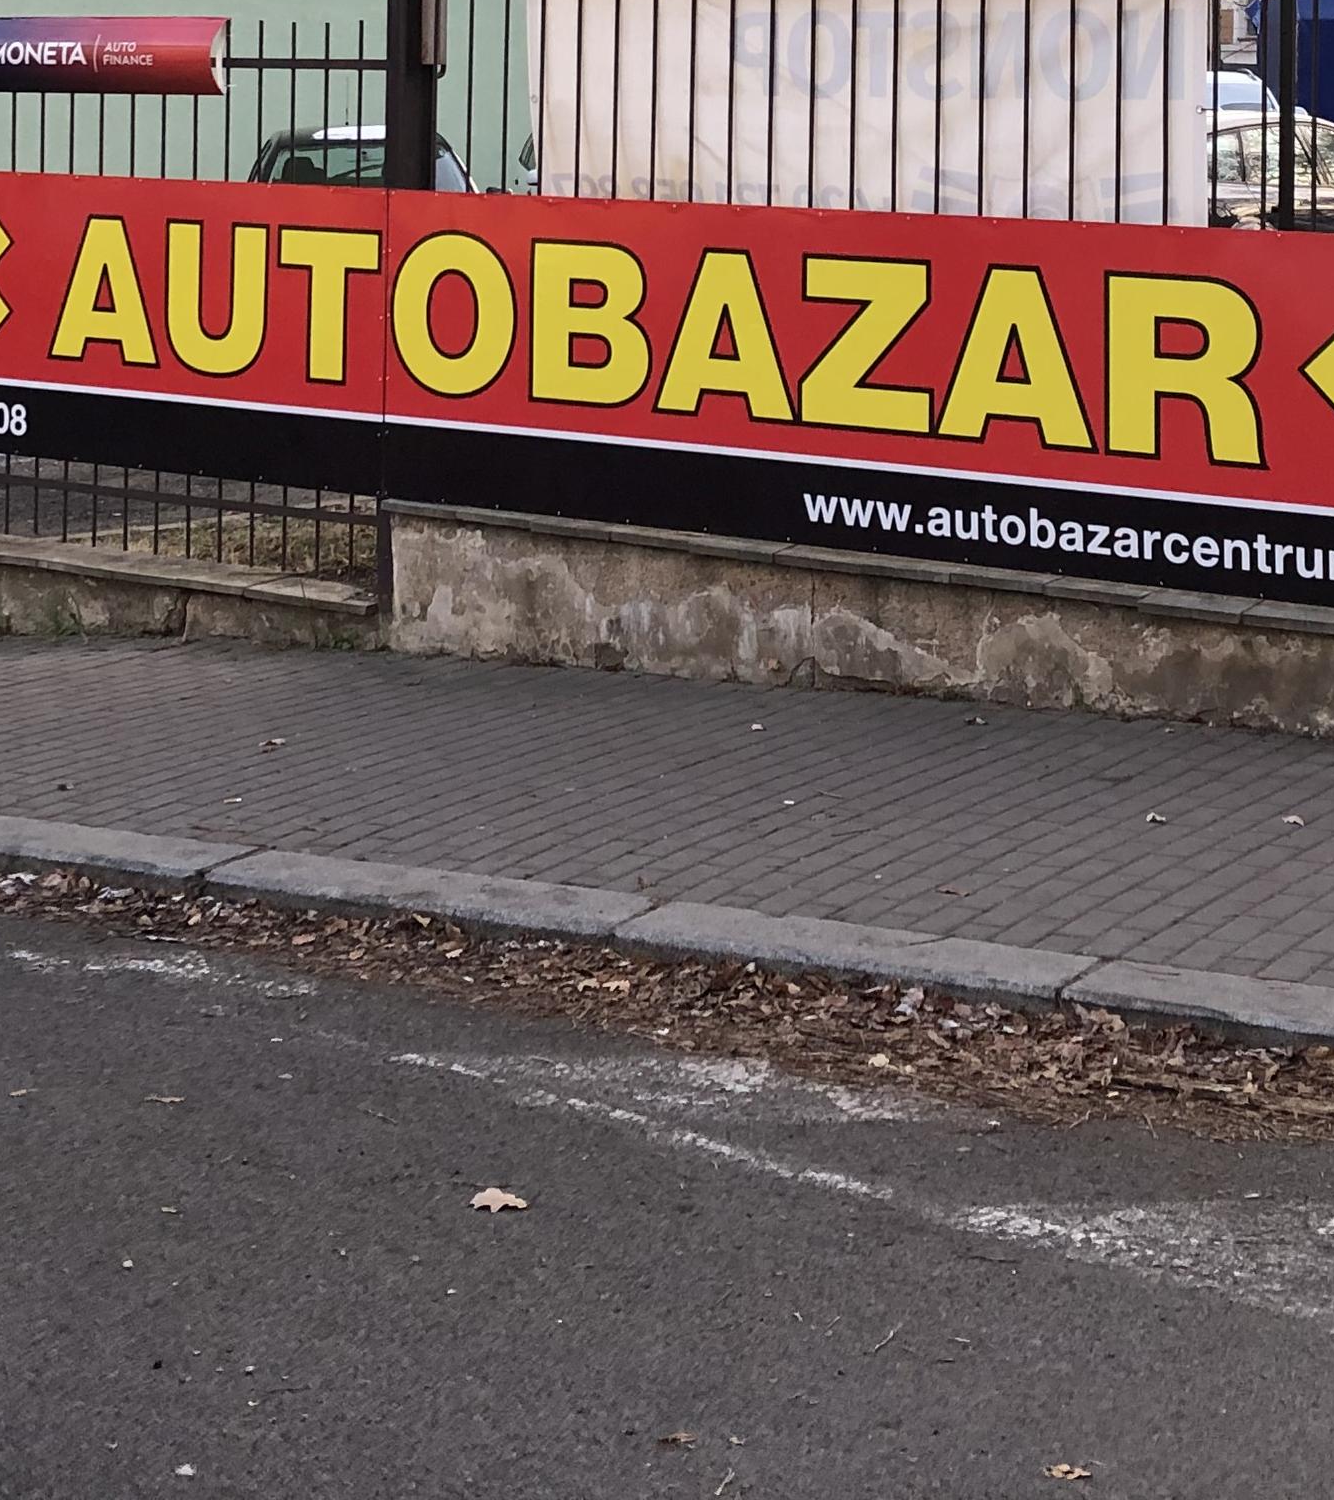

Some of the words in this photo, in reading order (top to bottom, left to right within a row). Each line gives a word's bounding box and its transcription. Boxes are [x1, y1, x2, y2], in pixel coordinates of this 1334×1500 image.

[104, 41, 137, 53] AUTO
[103, 54, 153, 66] FINANCE
[49, 215, 1263, 466] AUTOBAZAR
